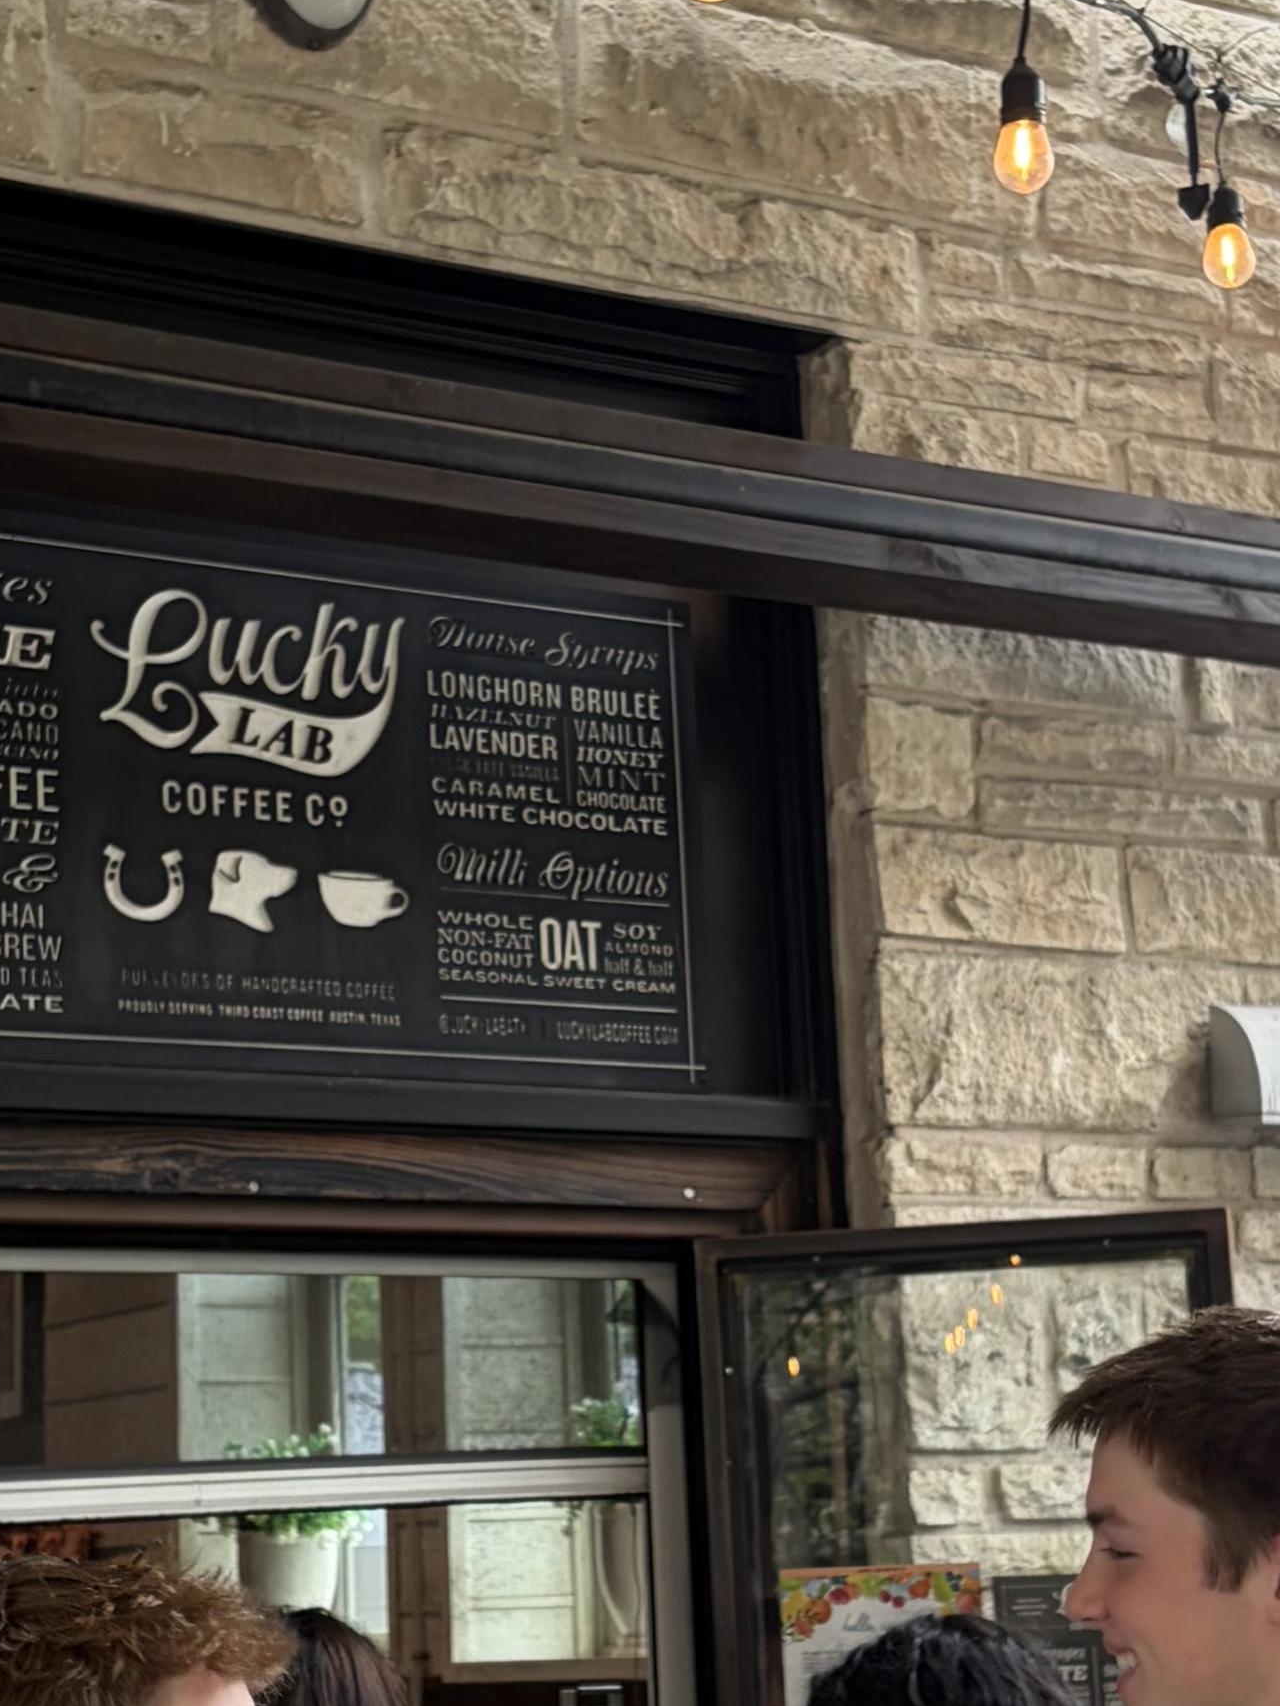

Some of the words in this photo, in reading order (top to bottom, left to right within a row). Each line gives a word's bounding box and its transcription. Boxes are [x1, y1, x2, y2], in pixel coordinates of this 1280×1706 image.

[428, 616, 536, 656] House
[544, 632, 659, 675] Syrups
[90, 588, 405, 749] Lucky
[426, 669, 562, 709] LONGHORN
[431, 703, 557, 730] HAZELNUT
[230, 706, 333, 764] LAB
[429, 723, 558, 761] LAVENDER
[573, 719, 664, 750] VANILLA
[576, 746, 665, 770] HONEY
[431, 777, 560, 804] CARAMEL
[577, 765, 666, 793] MINT
[161, 780, 293, 823] COFFEE
[576, 790, 666, 814] CHOCOLATE
[433, 799, 516, 823] WHITE
[522, 807, 668, 836] CHOCOLATE
[2, 853, 58, 893] &
[538, 851, 669, 900] Options
[437, 910, 534, 931] WHOLE
[613, 923, 662, 941] SOY
[437, 928, 534, 950] NON-FAT
[539, 918, 602, 972] OAT
[605, 942, 673, 957] ALMOND
[438, 948, 534, 968] COCONUT
[20, 966, 64, 990] TEAS
[242, 975, 341, 999] HANDCRAFTED
[345, 982, 396, 1001] COFFEE
[438, 969, 538, 986] SEASONAL
[543, 975, 606, 990] SWEET
[612, 980, 676, 994] CREAM
[118, 999, 165, 1015] PROUDLY
[169, 1001, 213, 1017] SERVING
[219, 1004, 250, 1020] THIRD
[252, 1006, 285, 1022] COAST
[287, 1008, 324, 1024] COFFEE
